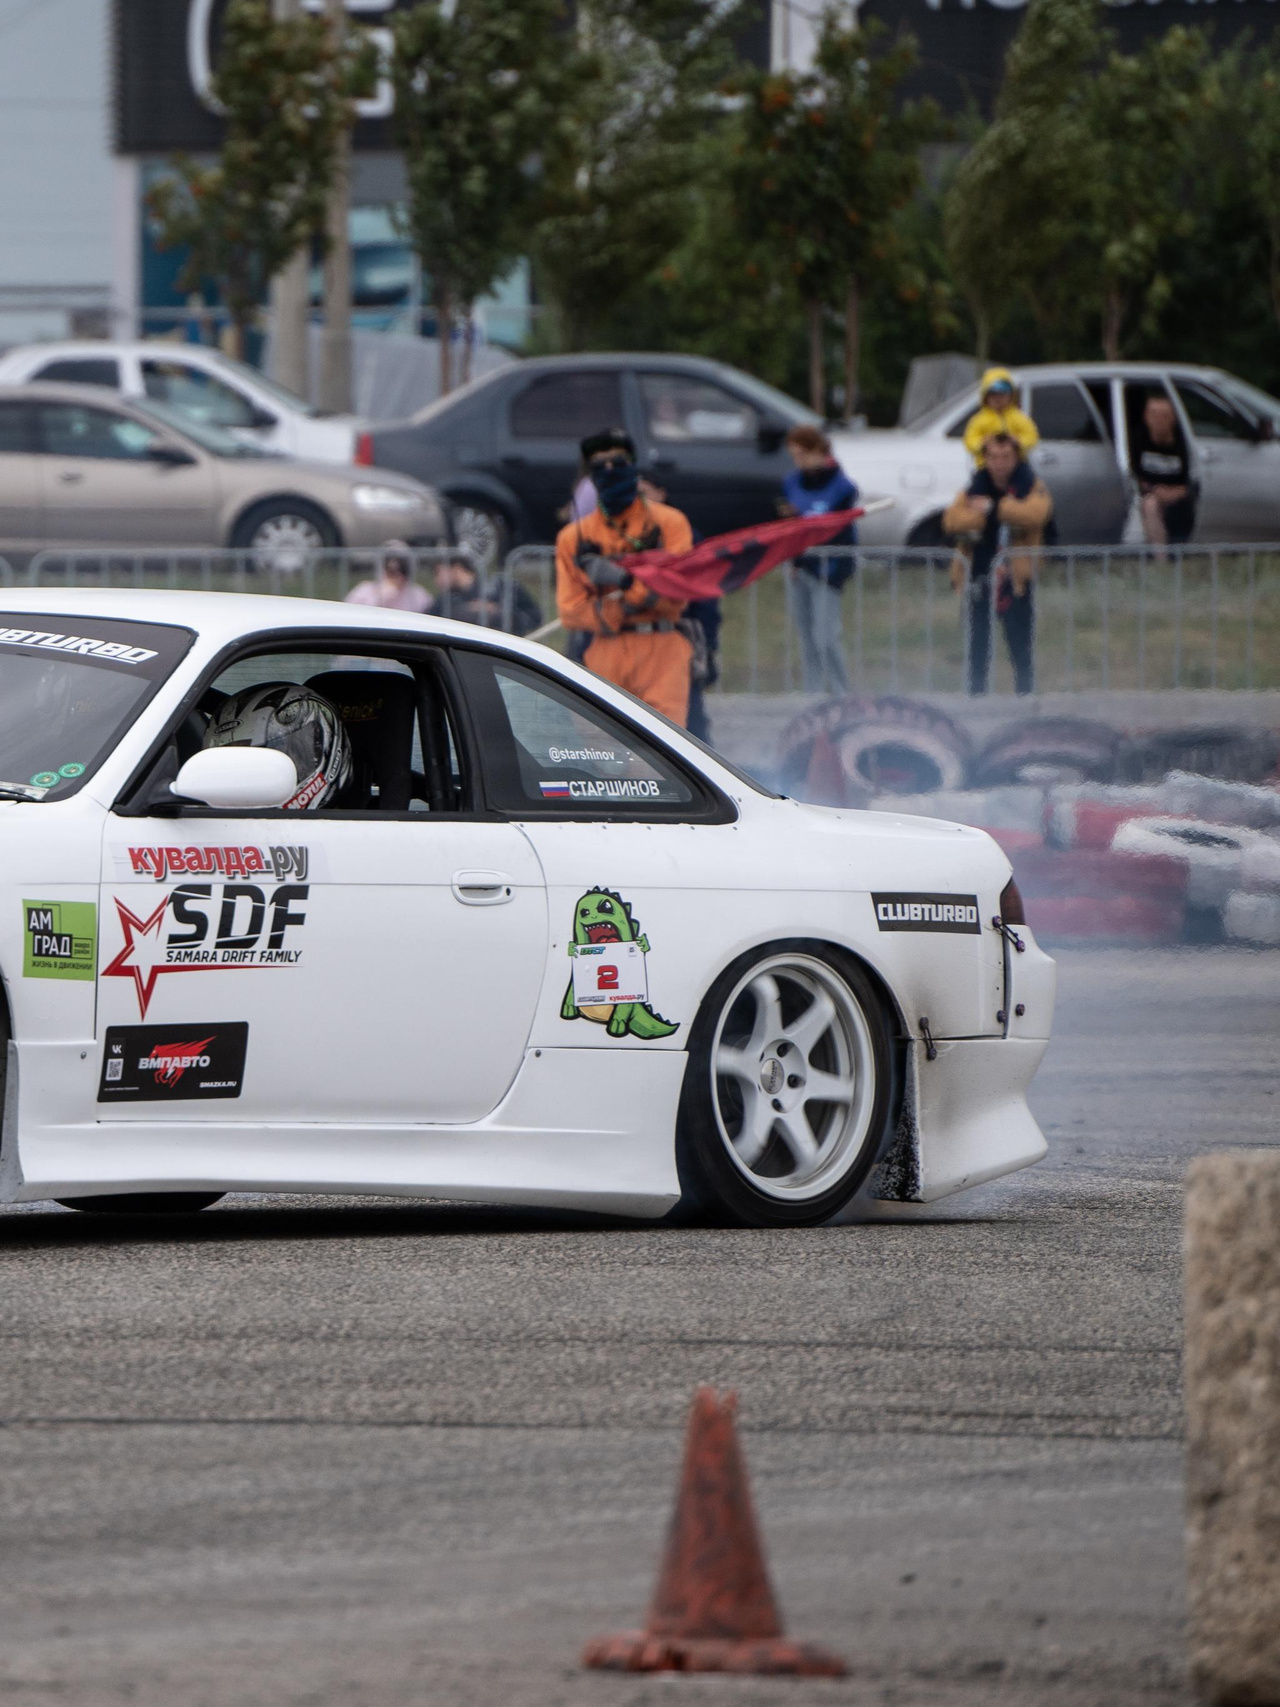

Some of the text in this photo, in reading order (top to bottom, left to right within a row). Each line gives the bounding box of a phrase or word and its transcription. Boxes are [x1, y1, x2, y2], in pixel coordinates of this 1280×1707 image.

[287, 775, 326, 809] MOTUL
[569, 780, 660, 797] СТАРШИНОВ
[128, 846, 308, 882] кувалда.ру
[29, 910, 52, 931] АМ
[166, 883, 310, 950] SDF
[877, 903, 978, 923] CLUBTURBO
[34, 934, 71, 956] ГРАД
[166, 950, 303, 963] SAMARA DRIFT FAMILY
[597, 965, 619, 990] 2
[138, 1055, 211, 1069] ВМПАВТО
